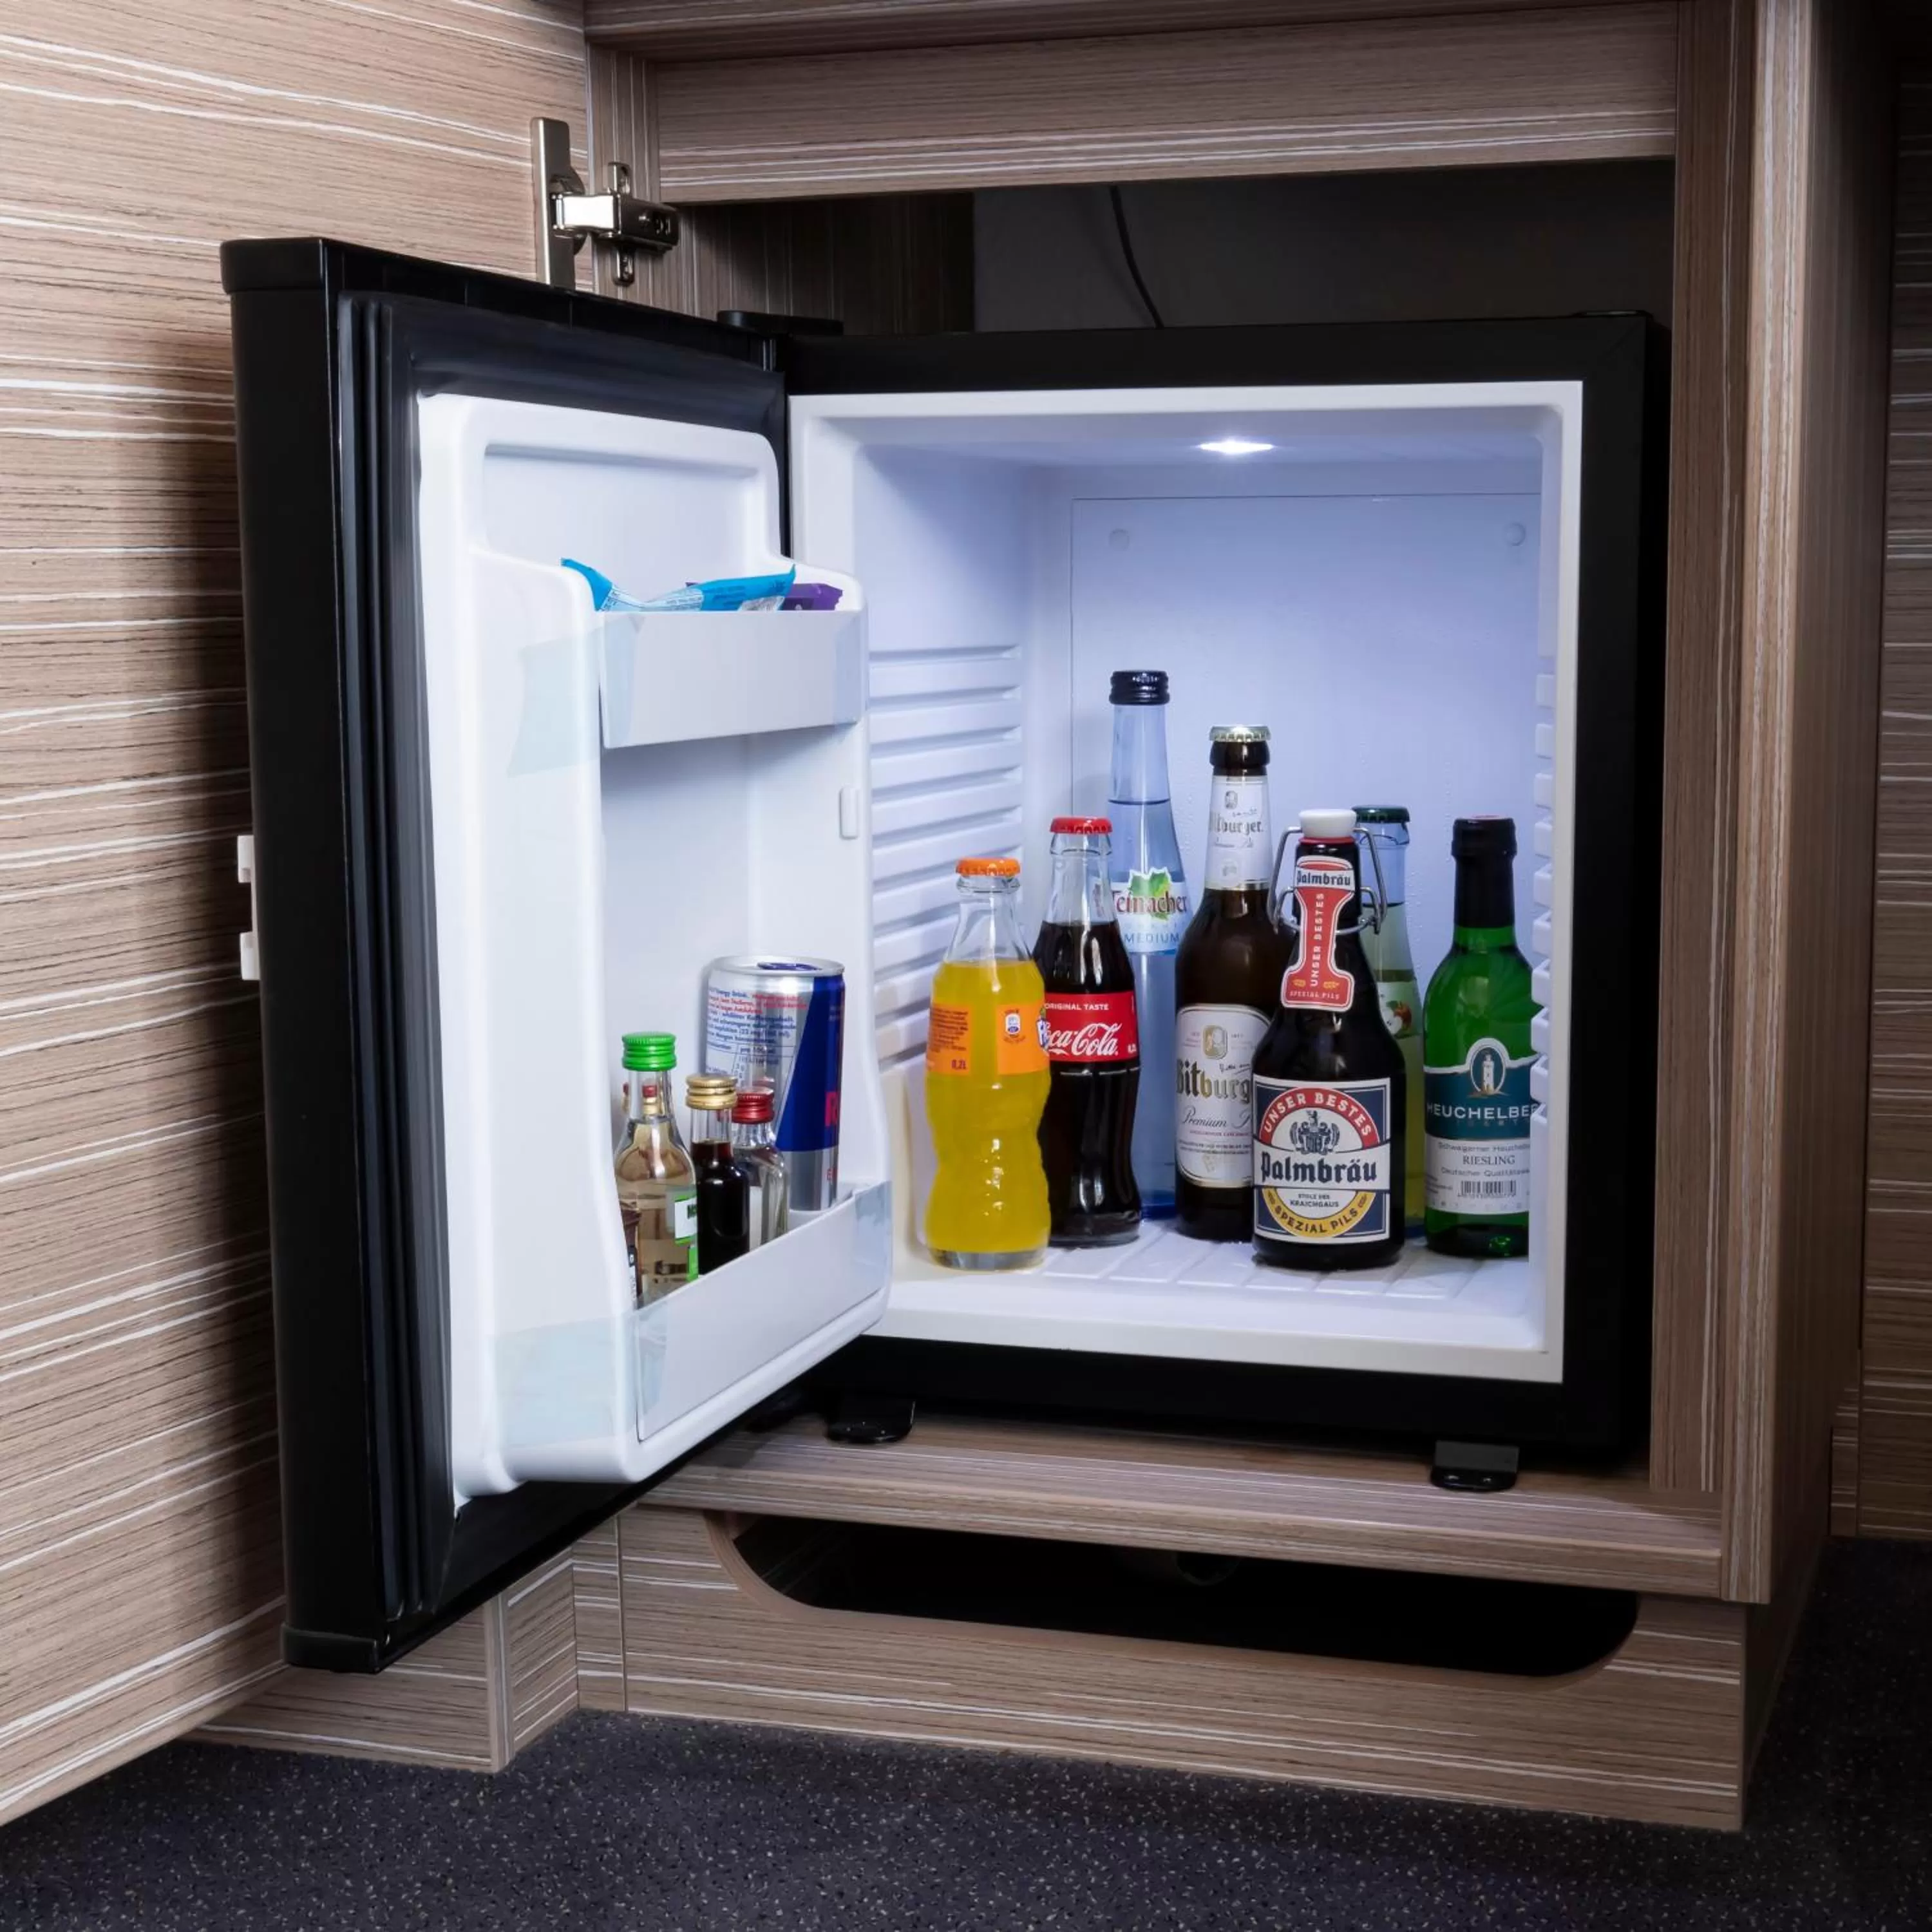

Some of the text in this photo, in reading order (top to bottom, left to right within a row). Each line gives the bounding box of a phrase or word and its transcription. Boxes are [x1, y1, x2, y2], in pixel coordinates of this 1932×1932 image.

[1297, 871, 1351, 886] Palmbräu
[1124, 932, 1179, 943] MEDIUM
[1311, 893, 1325, 987] UNSER BESTES
[1177, 1059, 1251, 1104] Bitburg
[1182, 1105, 1227, 1128] Premium
[1264, 1093, 1307, 1133] UNSER
[1314, 1092, 1371, 1135] BESTES
[1261, 1150, 1377, 1184] Palmbräu
[1463, 1155, 1515, 1165] RIESLING
[1274, 1205, 1358, 1233] SPEZIAL PILS
